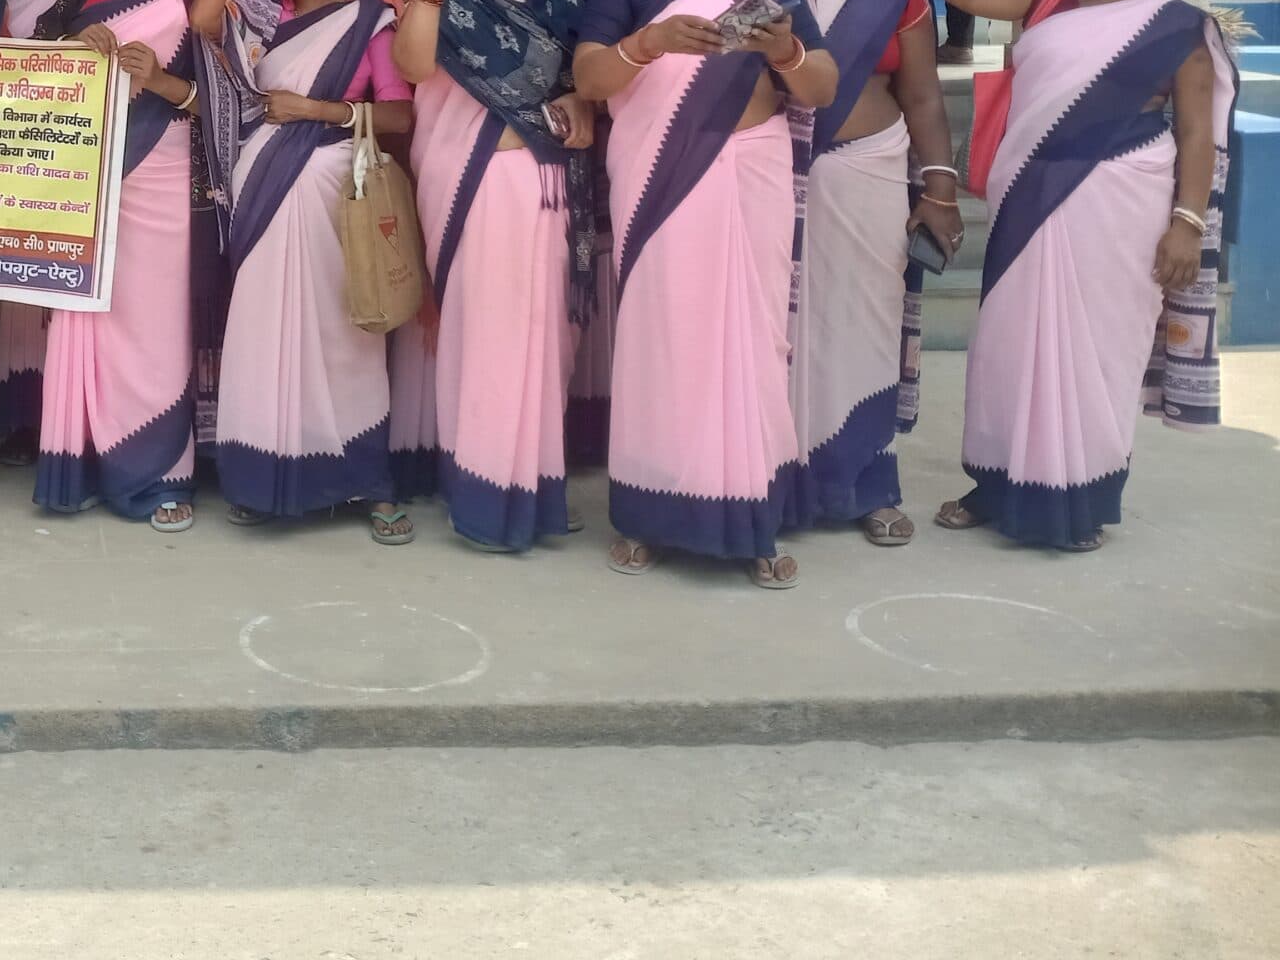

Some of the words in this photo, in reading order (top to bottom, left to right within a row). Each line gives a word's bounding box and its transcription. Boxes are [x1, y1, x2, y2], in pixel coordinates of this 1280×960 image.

[77, 59, 98, 76] मद
[6, 77, 55, 101] अविलम्ब
[3, 107, 37, 123] विभाग
[40, 111, 53, 124] में
[53, 113, 92, 128] कार्यरत
[82, 134, 98, 147] को
[16, 164, 40, 177] शशि
[42, 168, 70, 179] यादव
[73, 170, 89, 180] का
[4, 196, 16, 207] के
[47, 240, 85, 260] प्राणपुर
